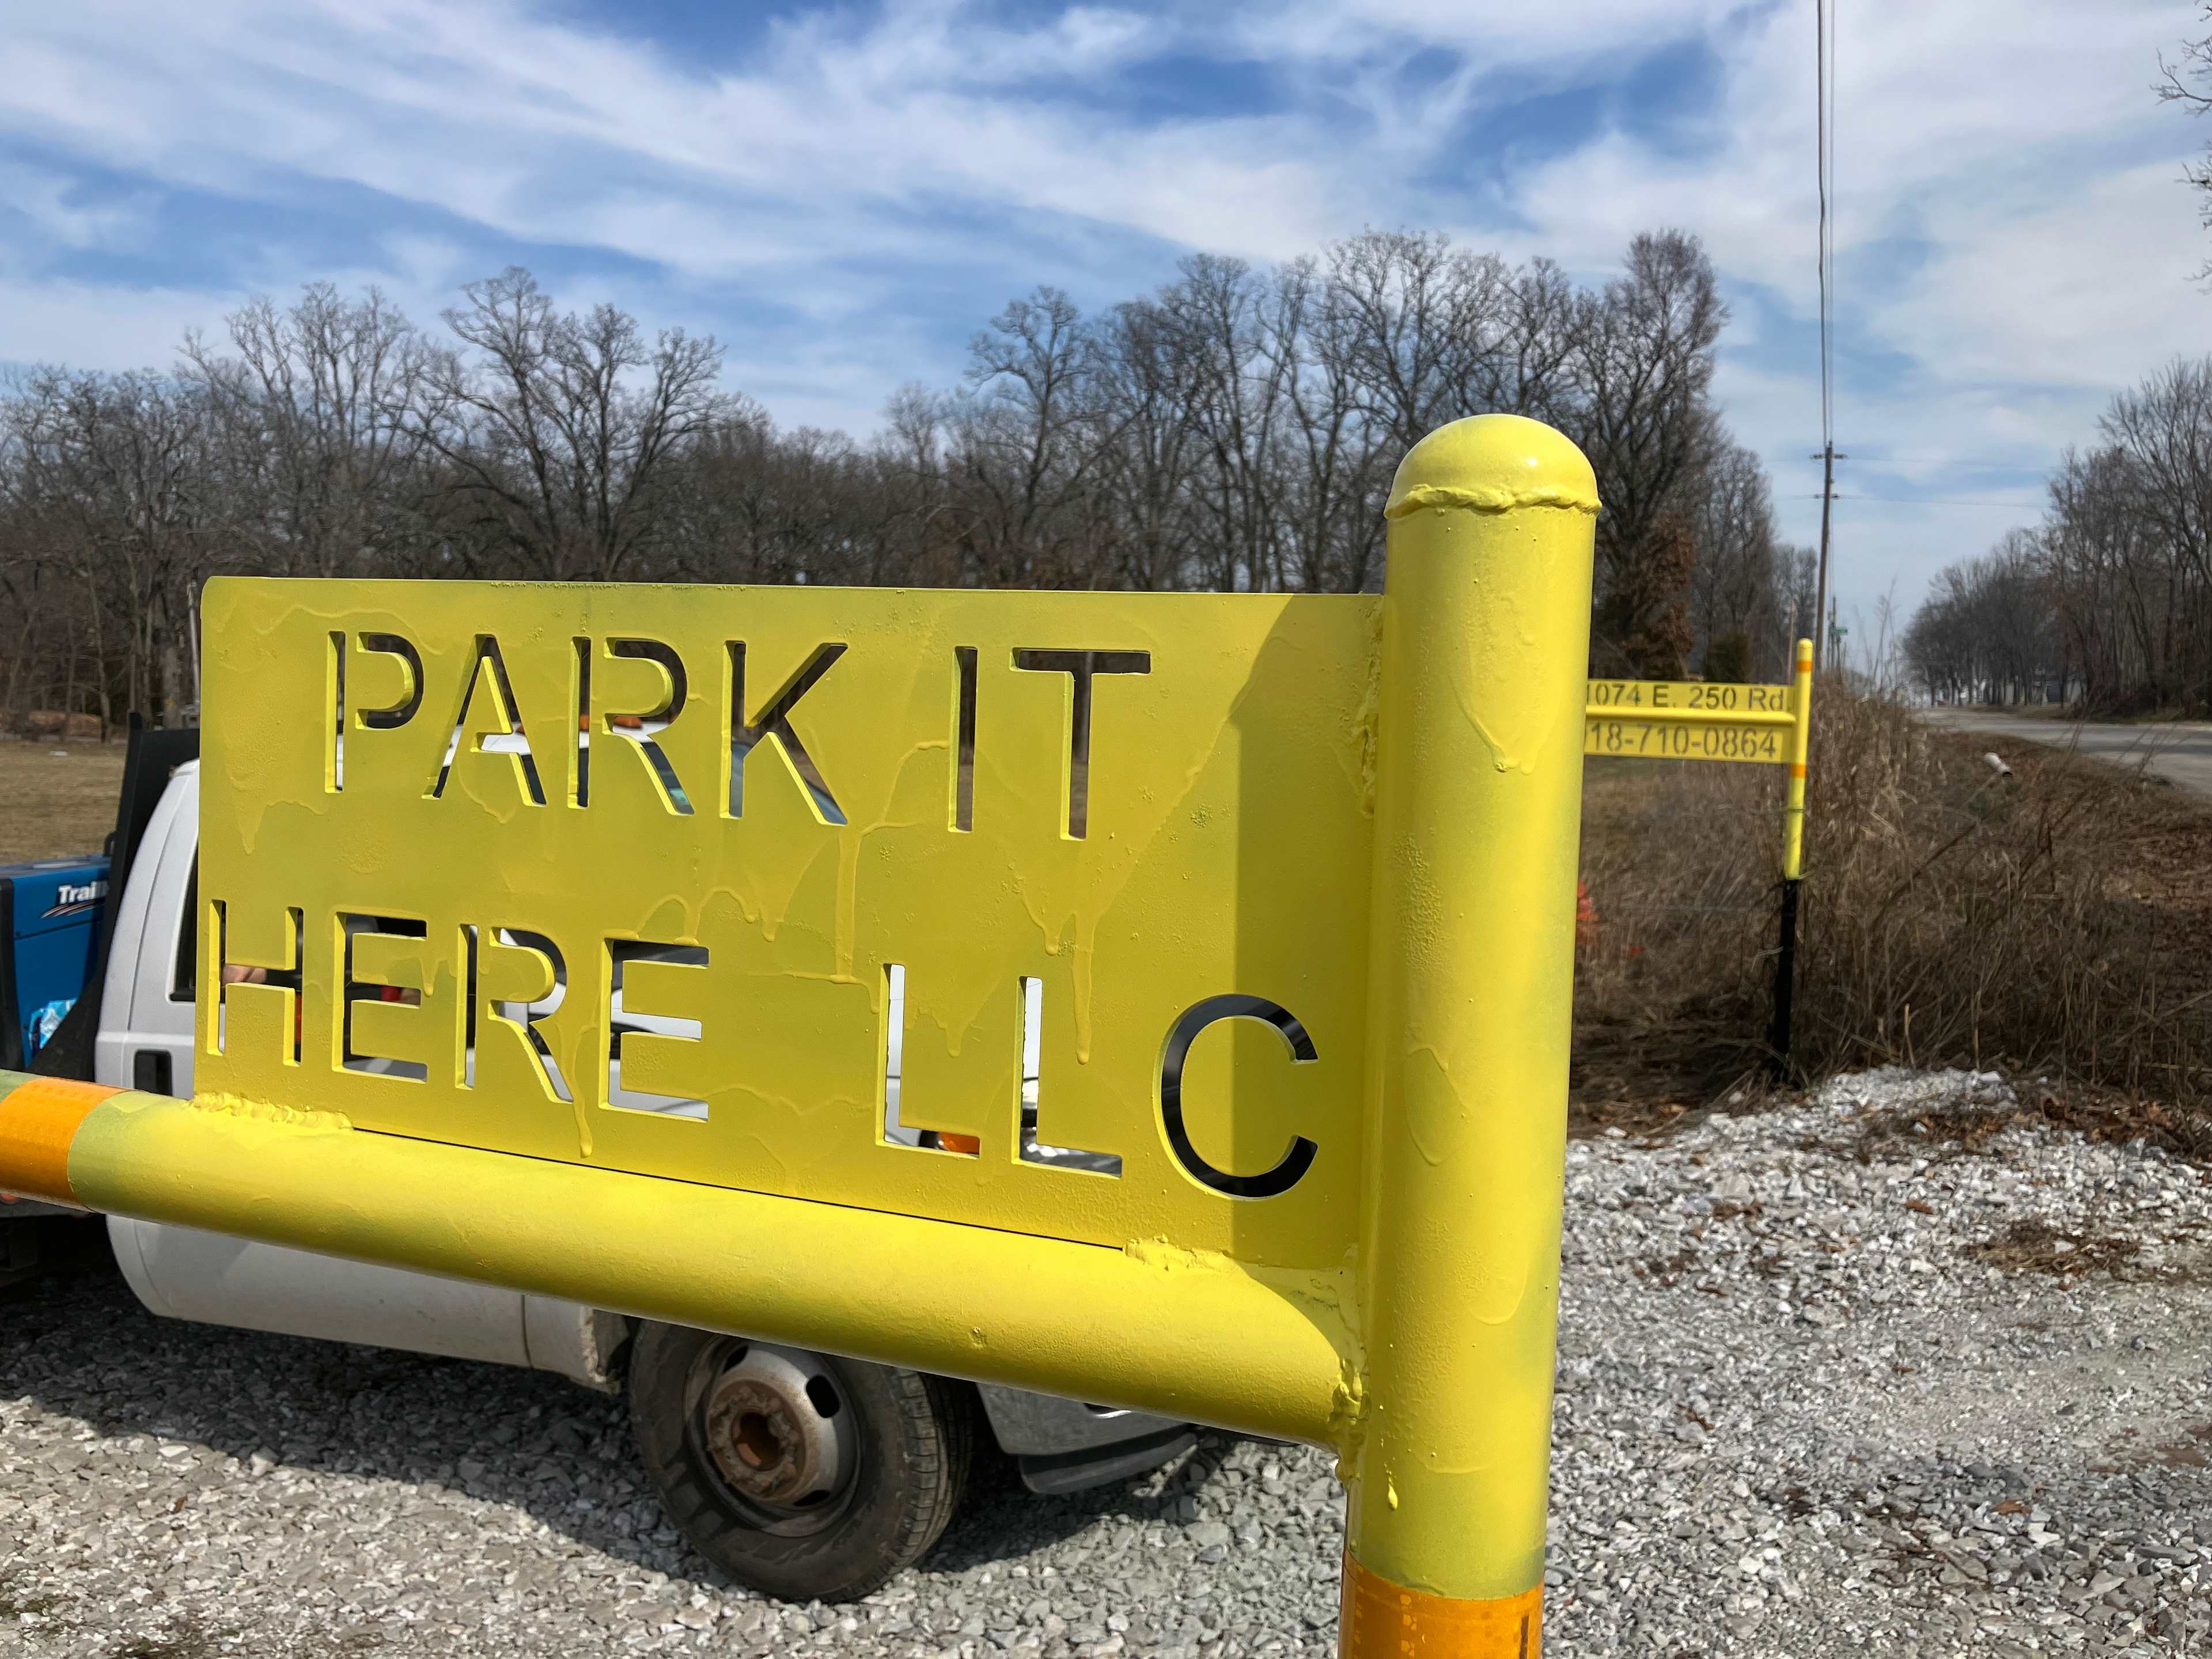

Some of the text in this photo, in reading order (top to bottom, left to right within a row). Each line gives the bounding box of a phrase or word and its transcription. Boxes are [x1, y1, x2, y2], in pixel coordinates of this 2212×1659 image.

[324, 630, 1152, 841] PARK IT
[1585, 722, 1776, 757] 18-710-0864
[1586, 681, 1641, 706] 1074
[1688, 685, 1737, 710] 250
[207, 899, 1319, 1201] HERE LLC
